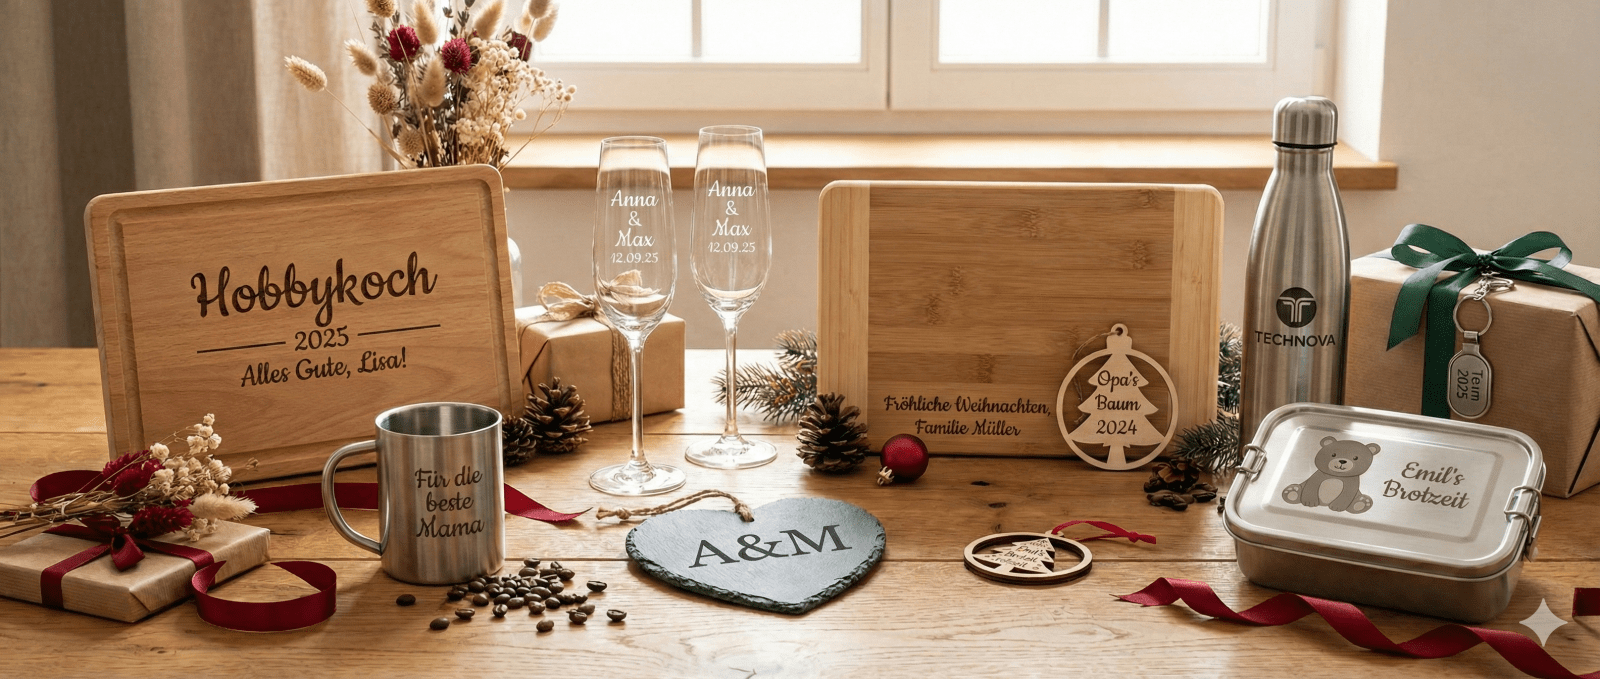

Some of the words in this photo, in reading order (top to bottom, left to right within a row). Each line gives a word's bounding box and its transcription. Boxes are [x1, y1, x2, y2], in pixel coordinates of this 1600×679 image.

[611, 189, 659, 207] Anna
[708, 180, 756, 197] Anna
[725, 200, 739, 216] &
[628, 210, 642, 227] &
[712, 217, 752, 236] Max
[615, 227, 655, 247] Max
[708, 241, 756, 253] 12.09.25
[611, 252, 659, 264] 12.09.25
[191, 251, 438, 327] Hobbykoch
[294, 325, 350, 351] 2025
[1254, 330, 1336, 348] TECHNOVA
[241, 362, 291, 387] Alles
[296, 358, 352, 380] Gute,
[357, 347, 407, 374] Lisa!
[1097, 370, 1140, 393] Opa's
[1456, 369, 1469, 399] 2025
[883, 395, 952, 411] Fröhliche
[954, 395, 1051, 417] Weihnachten,
[1094, 394, 1141, 411] Baum
[915, 419, 969, 435] Familie
[971, 419, 1021, 436] Müller
[1096, 419, 1138, 435] 2024
[415, 468, 450, 488] Für
[1401, 461, 1465, 485] Emil's
[426, 491, 474, 512] beste
[1383, 479, 1470, 509] Brotzeit
[416, 514, 485, 538] Mama
[688, 524, 852, 568] A&M
